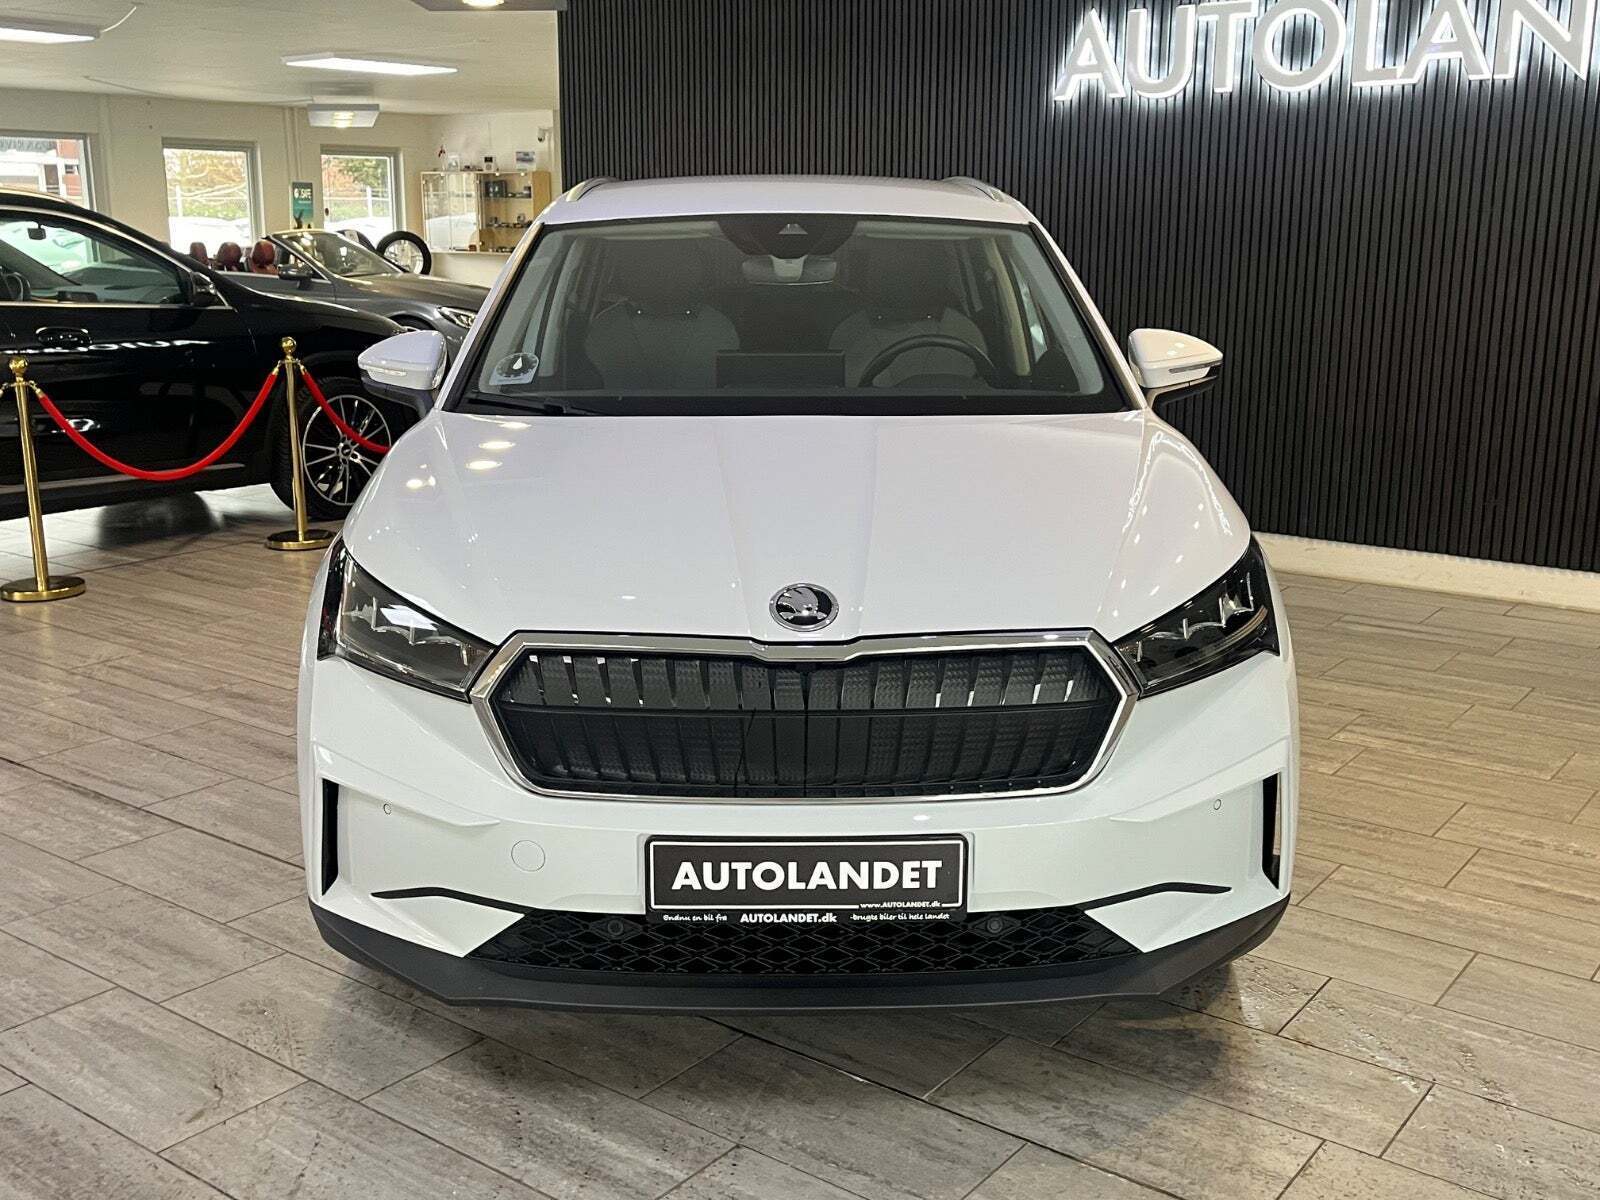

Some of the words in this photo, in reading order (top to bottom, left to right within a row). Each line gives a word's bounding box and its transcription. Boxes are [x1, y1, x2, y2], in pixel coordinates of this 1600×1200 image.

[671, 860, 943, 891] AUTOLANDET
[703, 913, 715, 921] bil
[715, 913, 728, 923] fra
[740, 912, 838, 923] AUTOLANDET.dk
[879, 913, 897, 921] biler
[897, 912, 908, 920] til
[924, 912, 950, 920] landet
